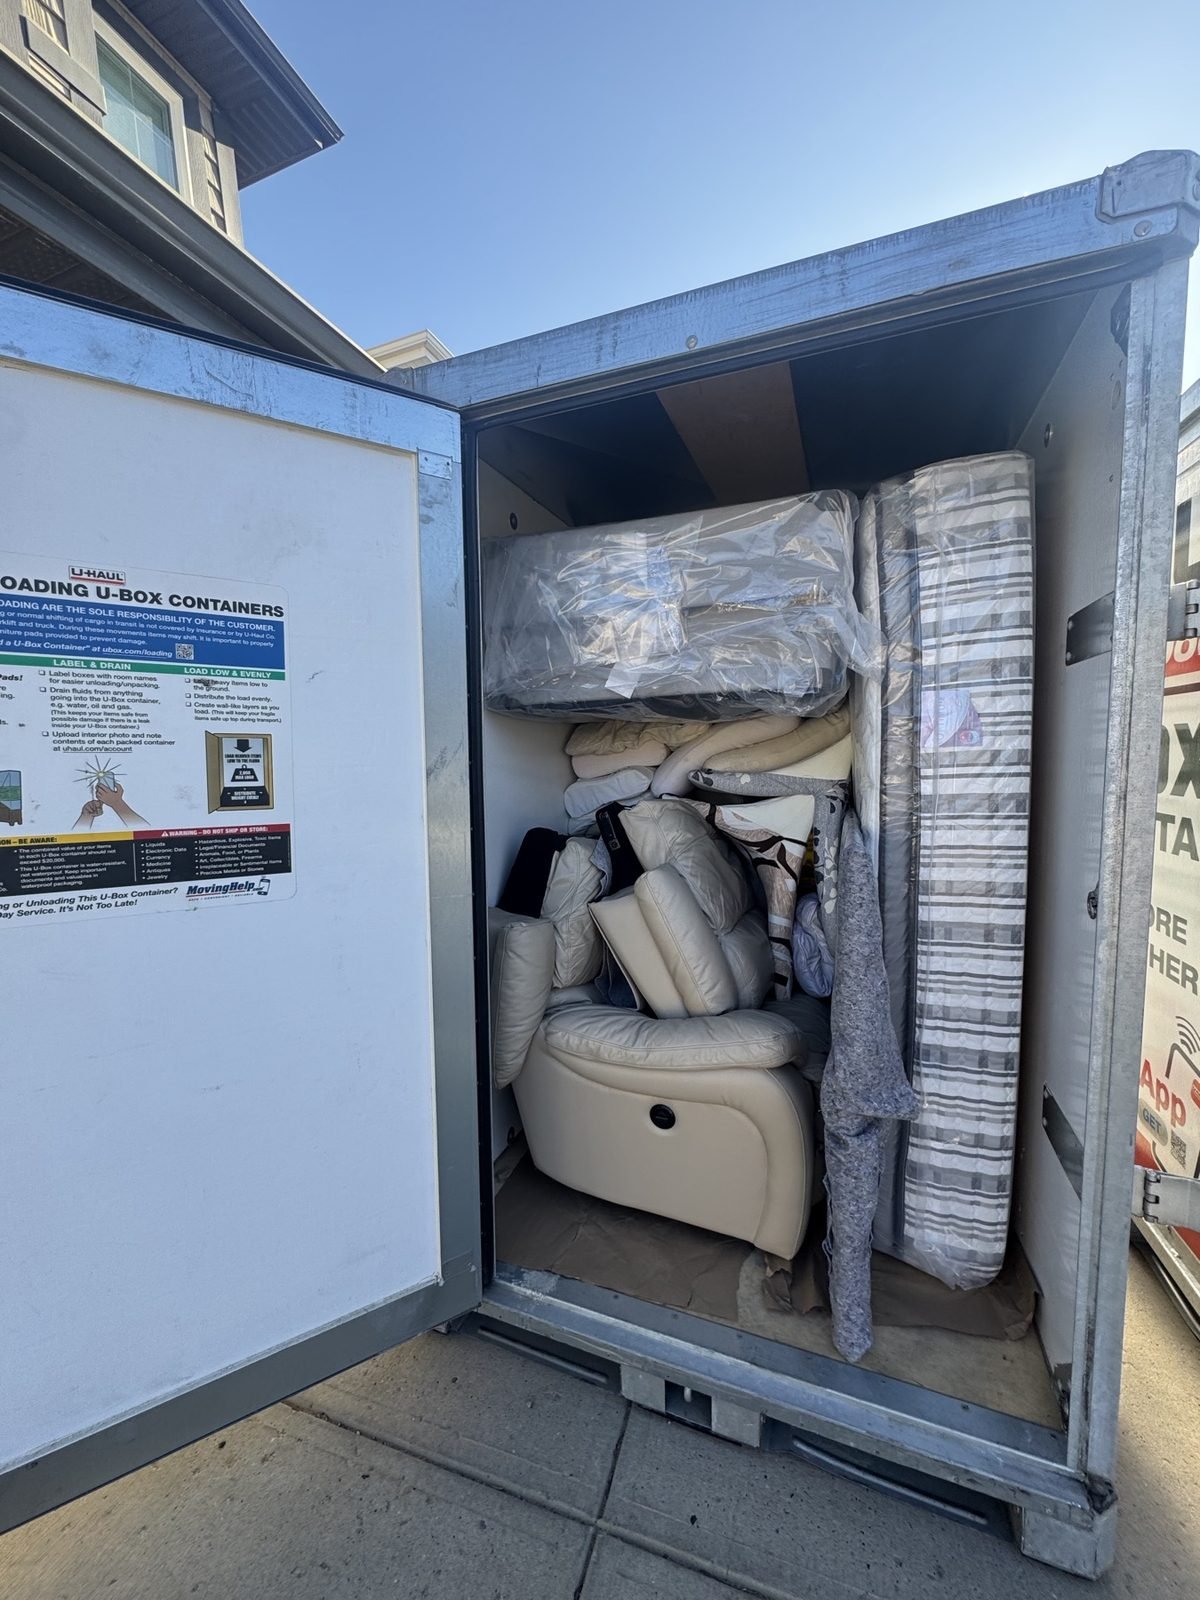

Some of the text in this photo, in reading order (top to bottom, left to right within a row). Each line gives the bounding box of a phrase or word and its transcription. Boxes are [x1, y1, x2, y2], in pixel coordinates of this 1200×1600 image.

[71, 568, 124, 580] U-HAUL
[0, 576, 284, 618] OADING U-BOX CONTAINERS
[42, 604, 63, 612] ARE
[66, 606, 86, 614] THE
[89, 608, 115, 617] SOLE
[118, 611, 192, 624] RESPONSIBILITY
[209, 619, 225, 627] THE
[228, 621, 275, 632] CUSTOMER.
[46, 632, 78, 640] provided
[118, 637, 147, 646] damage.
[60, 624, 83, 632] During
[107, 628, 146, 636] movements
[213, 637, 241, 646] important
[251, 640, 274, 648] properly
[103, 647, 172, 658] ubox.com/loading
[53, 659, 87, 668] LABEL
[100, 662, 131, 670] DRAIN
[86, 680, 160, 689] unloading/unpacking.
[186, 881, 255, 896] MovingHelp
[26, 896, 76, 908] Unloading
[100, 892, 128, 900] U-Box
[131, 887, 178, 897] Container?
[17, 907, 56, 916] Service.
[1140, 1059, 1187, 1128] App
[1142, 1108, 1162, 1135] GET
